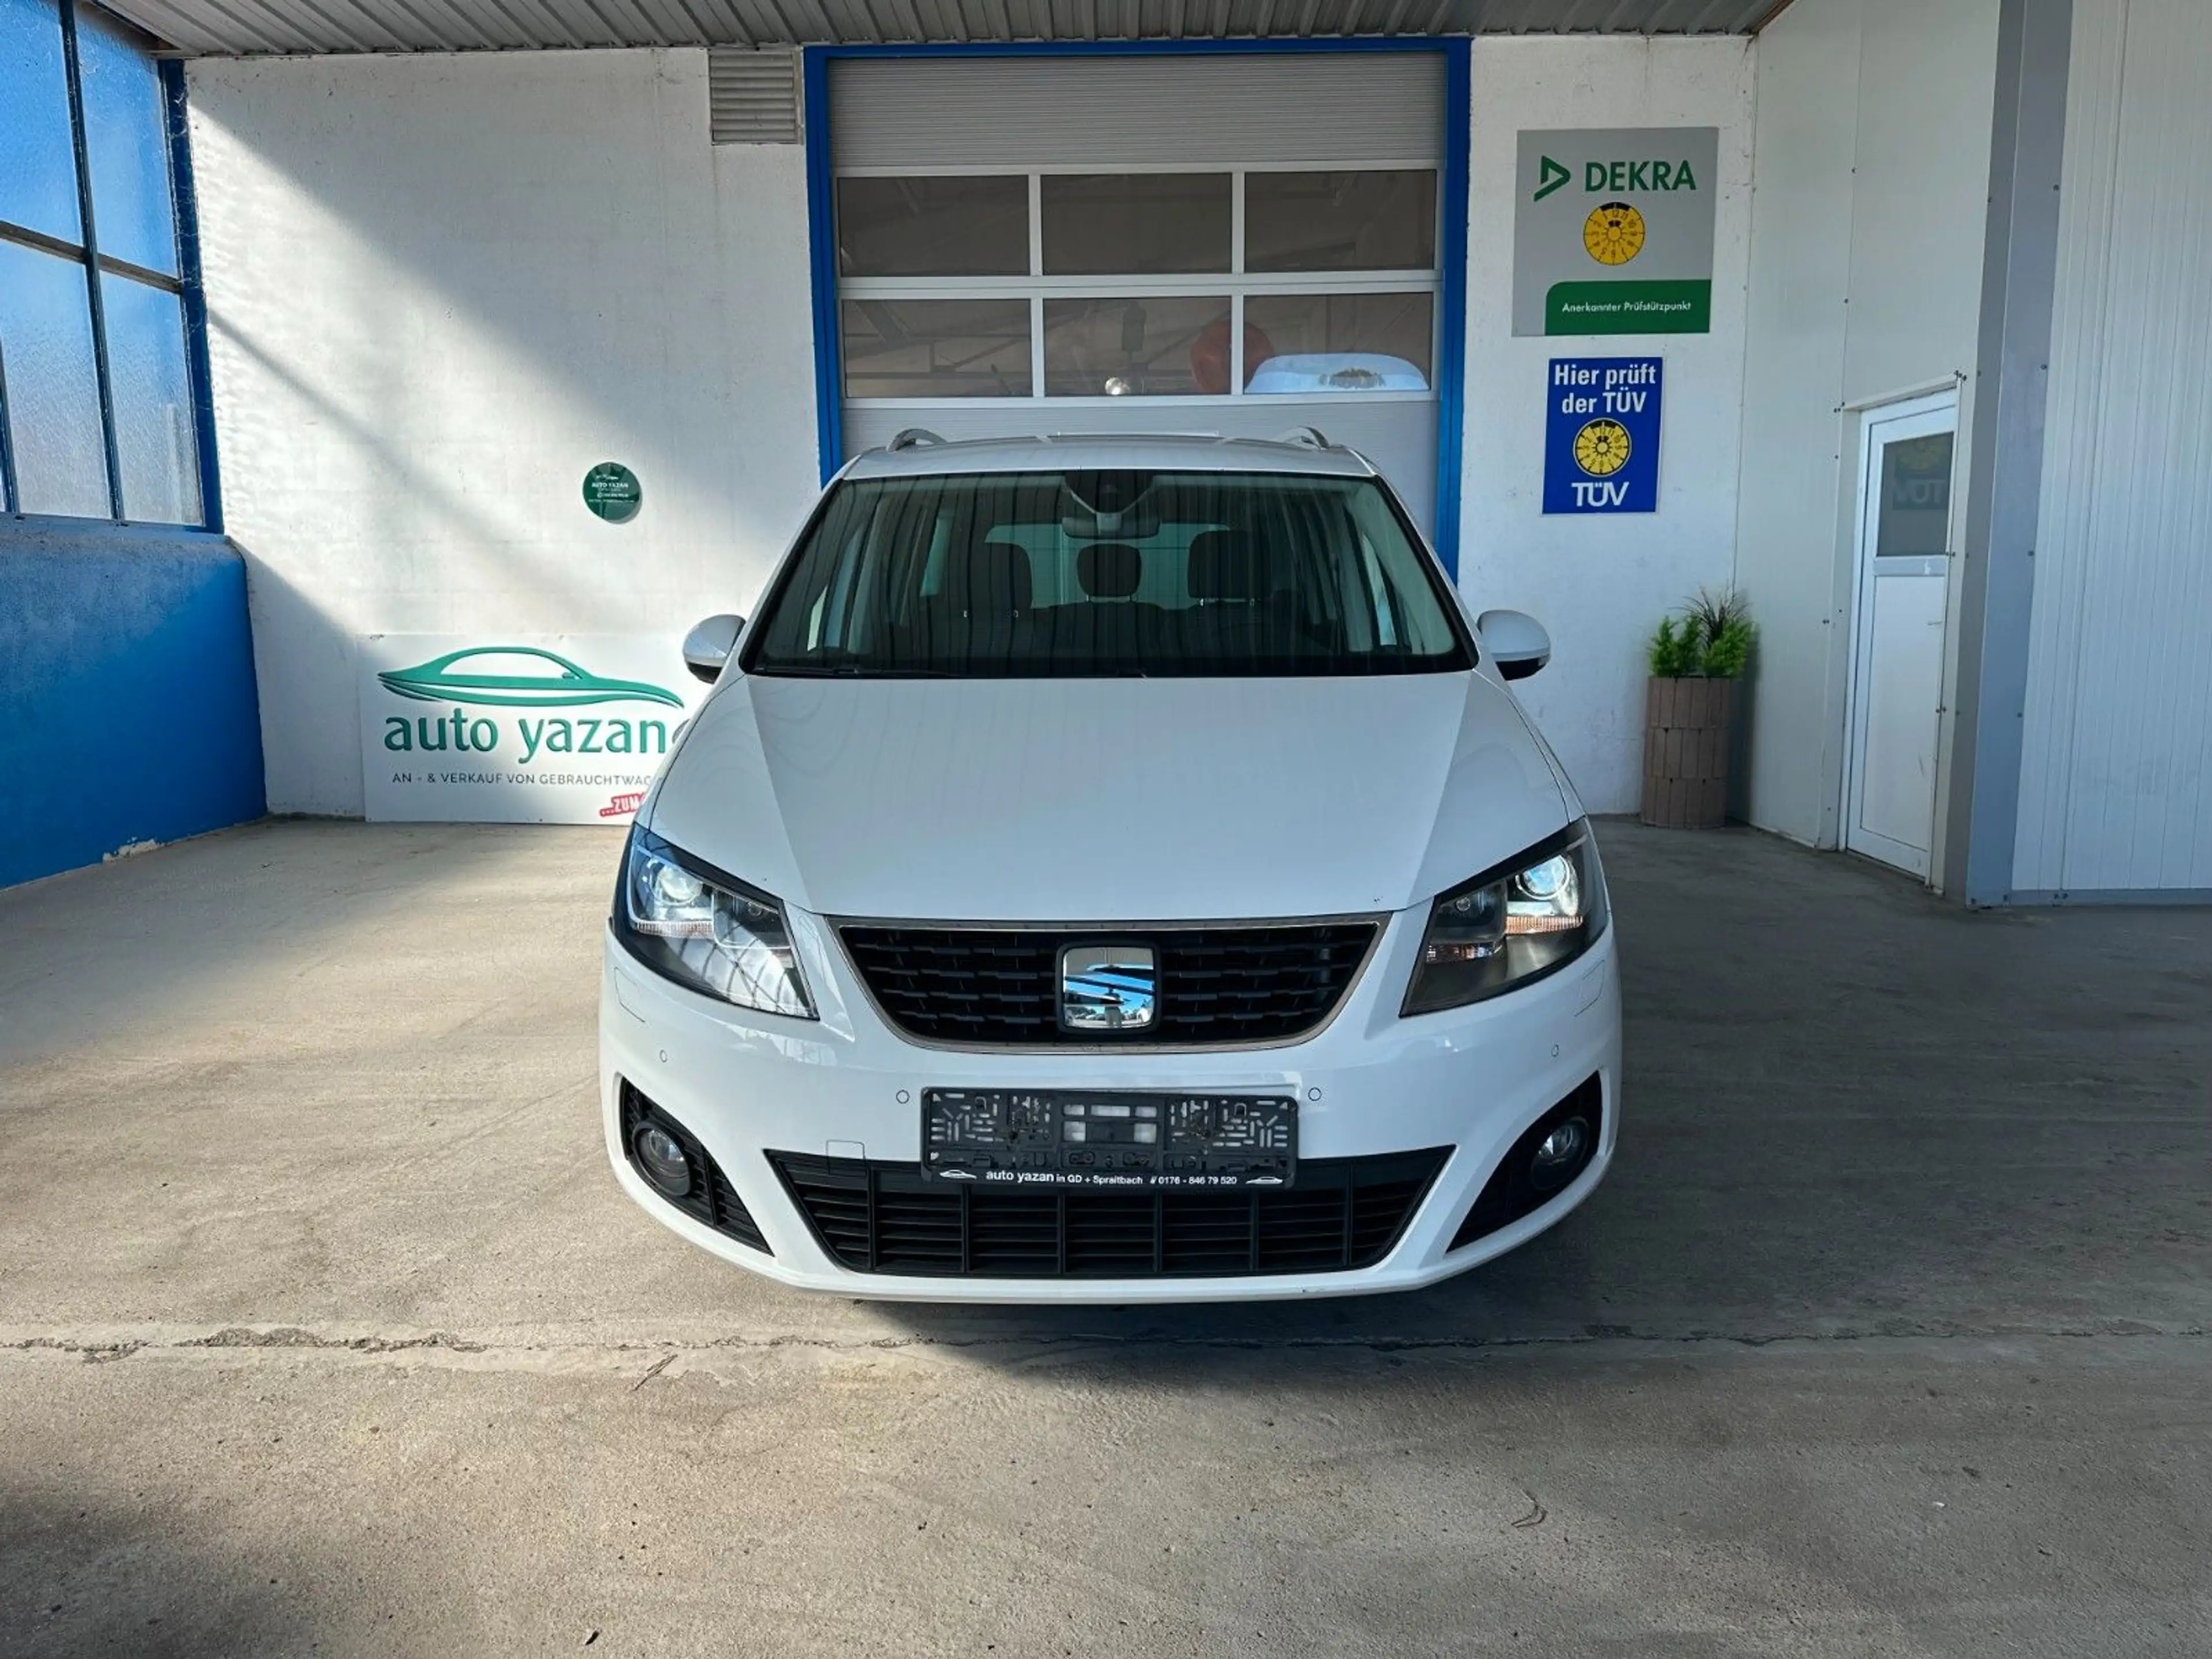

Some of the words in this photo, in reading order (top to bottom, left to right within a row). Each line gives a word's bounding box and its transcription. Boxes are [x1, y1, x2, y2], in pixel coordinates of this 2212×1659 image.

[1585, 160, 1696, 191] DEKRA
[1562, 302, 1620, 312] Anerkannter
[1624, 301, 1691, 312] Prüfstützpunkt
[1555, 364, 1600, 385] Hier
[1605, 363, 1656, 390] prüft
[1562, 392, 1597, 413] der
[1602, 387, 1647, 412] TÜV
[1571, 482, 1630, 506] TÜV
[384, 708, 498, 751] auto
[518, 719, 665, 764] yazan
[392, 773, 411, 783] AN
[427, 773, 435, 782] &
[441, 773, 503, 783] VERKAUF
[507, 774, 535, 784] VON
[986, 1171, 1014, 1180] auto
[1017, 1172, 1054, 1183] yazan
[1056, 1173, 1065, 1183] in
[1067, 1174, 1082, 1183] GD
[1093, 1175, 1143, 1185] Spraitbach
